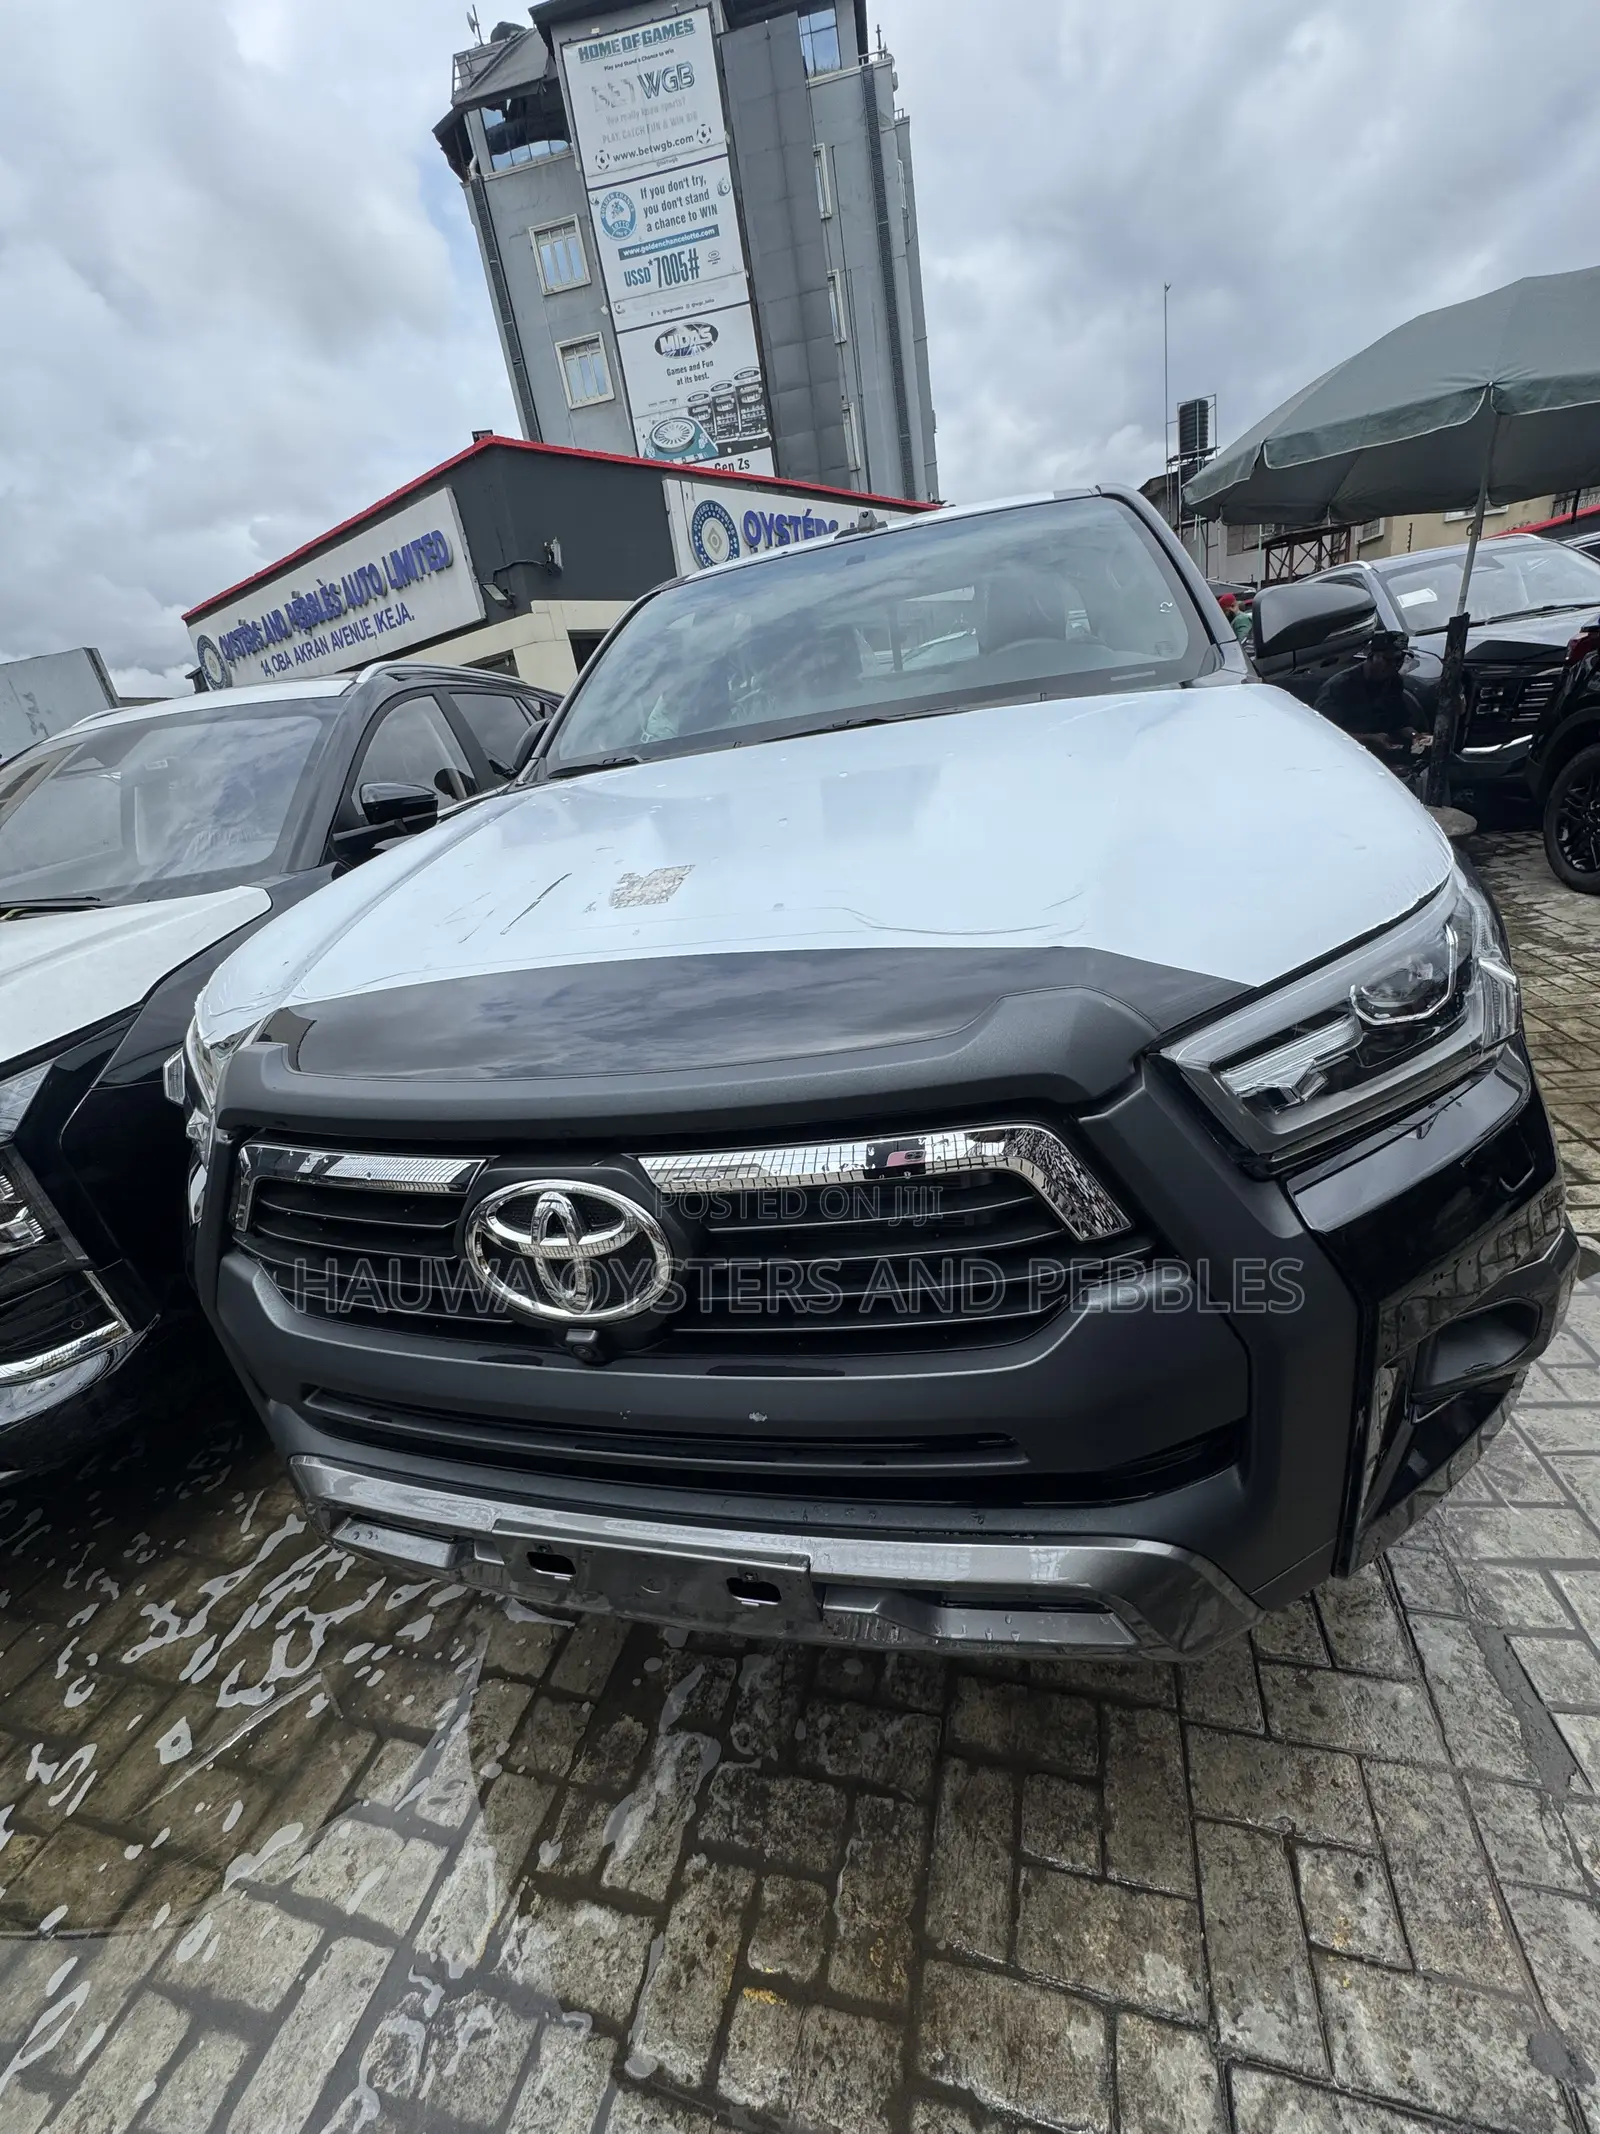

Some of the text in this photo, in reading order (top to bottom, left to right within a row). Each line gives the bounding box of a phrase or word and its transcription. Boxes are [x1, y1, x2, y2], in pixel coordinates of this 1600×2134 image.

[578, 18, 695, 63] HOME OF GAMES
[637, 61, 695, 99] WGB
[612, 134, 695, 162] www.betwgb.com
[640, 174, 707, 200] If you don't try,
[643, 189, 710, 218] you don't stand
[646, 203, 718, 232] a chance to WIN
[623, 228, 715, 256] www.goldenchancelotto.com
[659, 326, 713, 353] MIDAS
[666, 359, 714, 377] Games and Fun
[676, 371, 710, 386] at its best.
[737, 457, 751, 471] Zs
[261, 608, 289, 644] AND
[341, 562, 386, 609] AUTO
[381, 529, 452, 590] LIMITED
[271, 650, 294, 672] OBA
[293, 635, 331, 665] AKRAN
[330, 617, 378, 652] AVENUE,
[373, 602, 415, 634] IKEJA.
